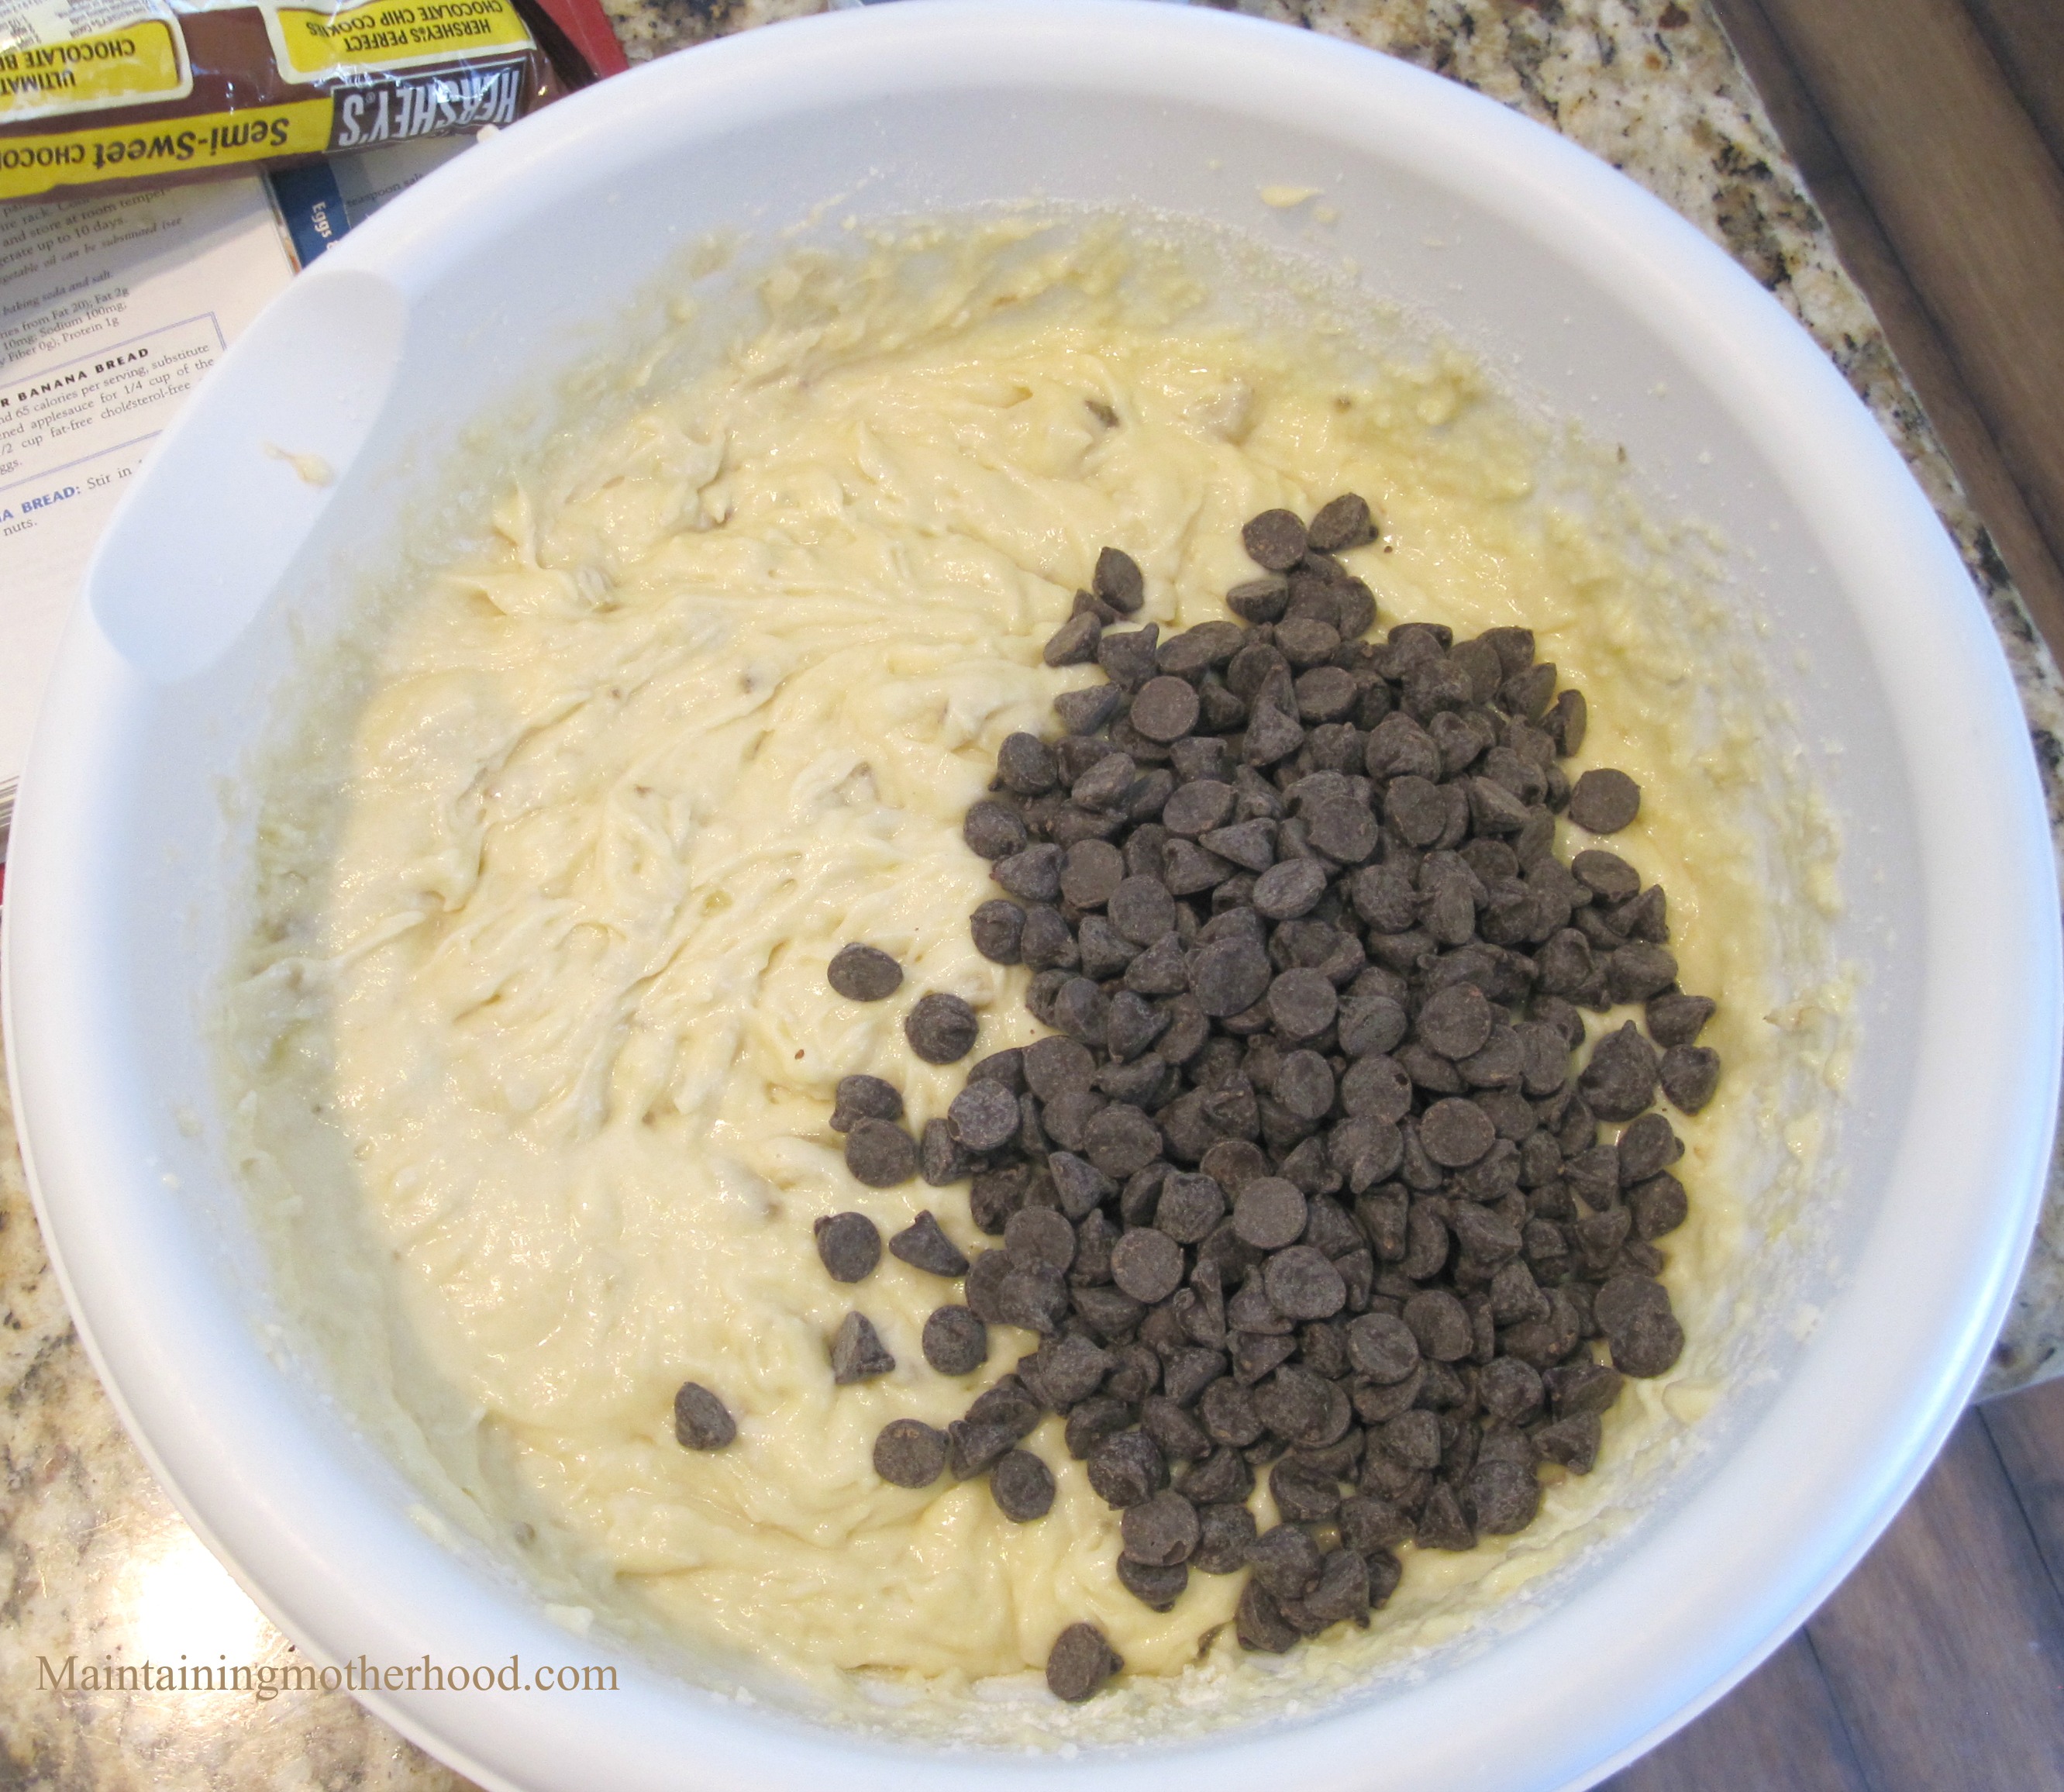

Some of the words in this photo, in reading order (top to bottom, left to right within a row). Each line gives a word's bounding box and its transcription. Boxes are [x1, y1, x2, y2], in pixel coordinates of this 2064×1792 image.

[381, 9, 417, 26] CHIP
[419, 0, 503, 21] CHOCOLATE
[306, 15, 376, 37] COOKIES
[344, 28, 408, 52] PERFECT
[26, 38, 136, 68] CHOCOLATE
[0, 144, 86, 171] CHOCO
[94, 118, 290, 170] Semi-Sweet
[3, 229, 26, 247] and
[30, 219, 61, 238] store
[312, 201, 333, 238] Eggs
[37, 239, 53, 251] up
[57, 234, 71, 243] to
[75, 225, 90, 238] 10
[22, 316, 50, 332] from
[52, 305, 69, 320] Fat
[95, 291, 113, 305] Fat
[115, 286, 130, 298] 2g
[8, 345, 37, 362] Fiber
[62, 322, 102, 342] Protein
[105, 316, 119, 328] 1g
[40, 317, 83, 338] Sodium
[16, 405, 29, 419] 65
[33, 391, 78, 412] calories
[81, 381, 100, 397] per
[104, 366, 149, 386] serving,
[152, 345, 210, 370] substitute
[18, 370, 88, 401] BANANA
[95, 348, 149, 374] BREAD
[31, 399, 95, 429] applesauce
[100, 391, 117, 404] for
[124, 381, 143, 395] 1/4
[149, 373, 171, 385] cup
[177, 364, 190, 376] of
[195, 357, 215, 370] the
[21, 436, 43, 447] cup
[50, 416, 93, 439] fat-free
[101, 381, 191, 419] cholesterol-free
[0, 508, 14, 523] A
[22, 486, 81, 514] BREAD:
[87, 474, 112, 490] Stir
[118, 467, 132, 478] in
[3, 519, 37, 536] nuts.
